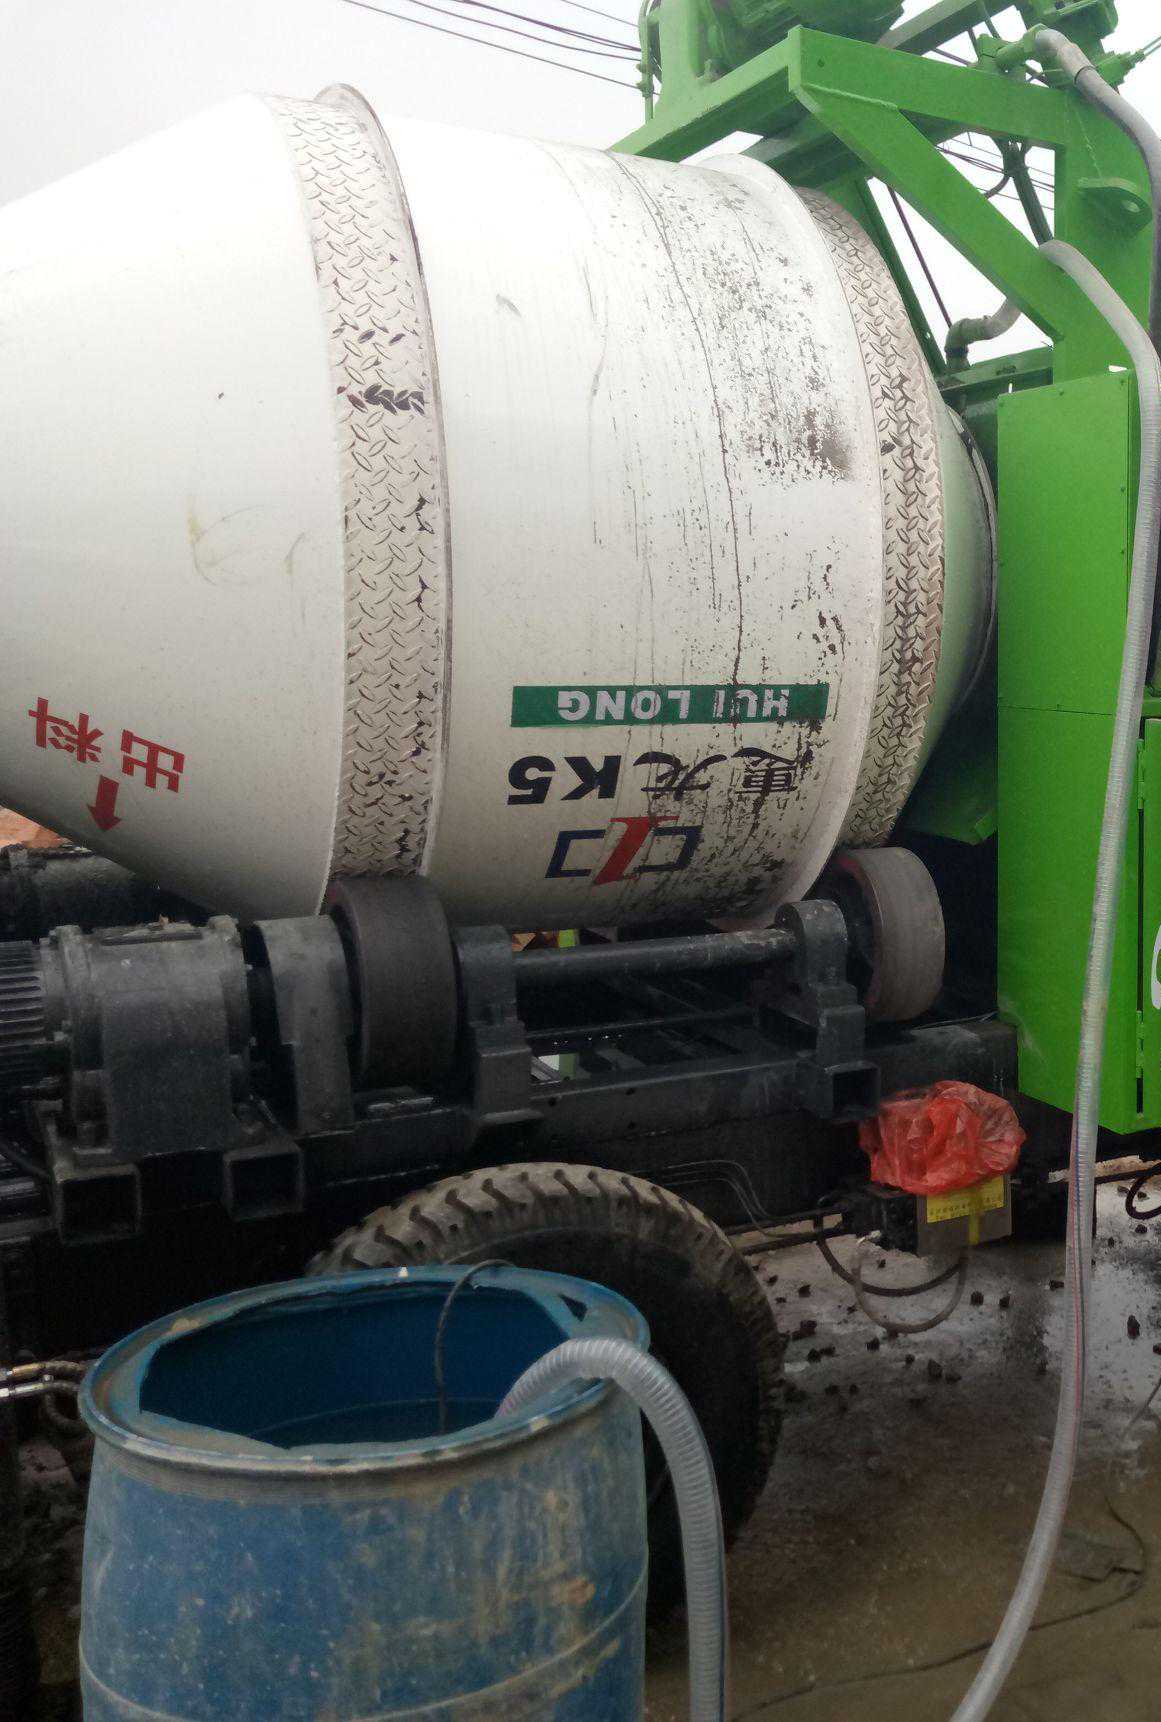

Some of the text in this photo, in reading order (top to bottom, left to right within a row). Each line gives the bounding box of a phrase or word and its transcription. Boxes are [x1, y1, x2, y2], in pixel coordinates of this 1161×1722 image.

[556, 688, 791, 721] HUI LONG
[28, 696, 185, 793] 出料
